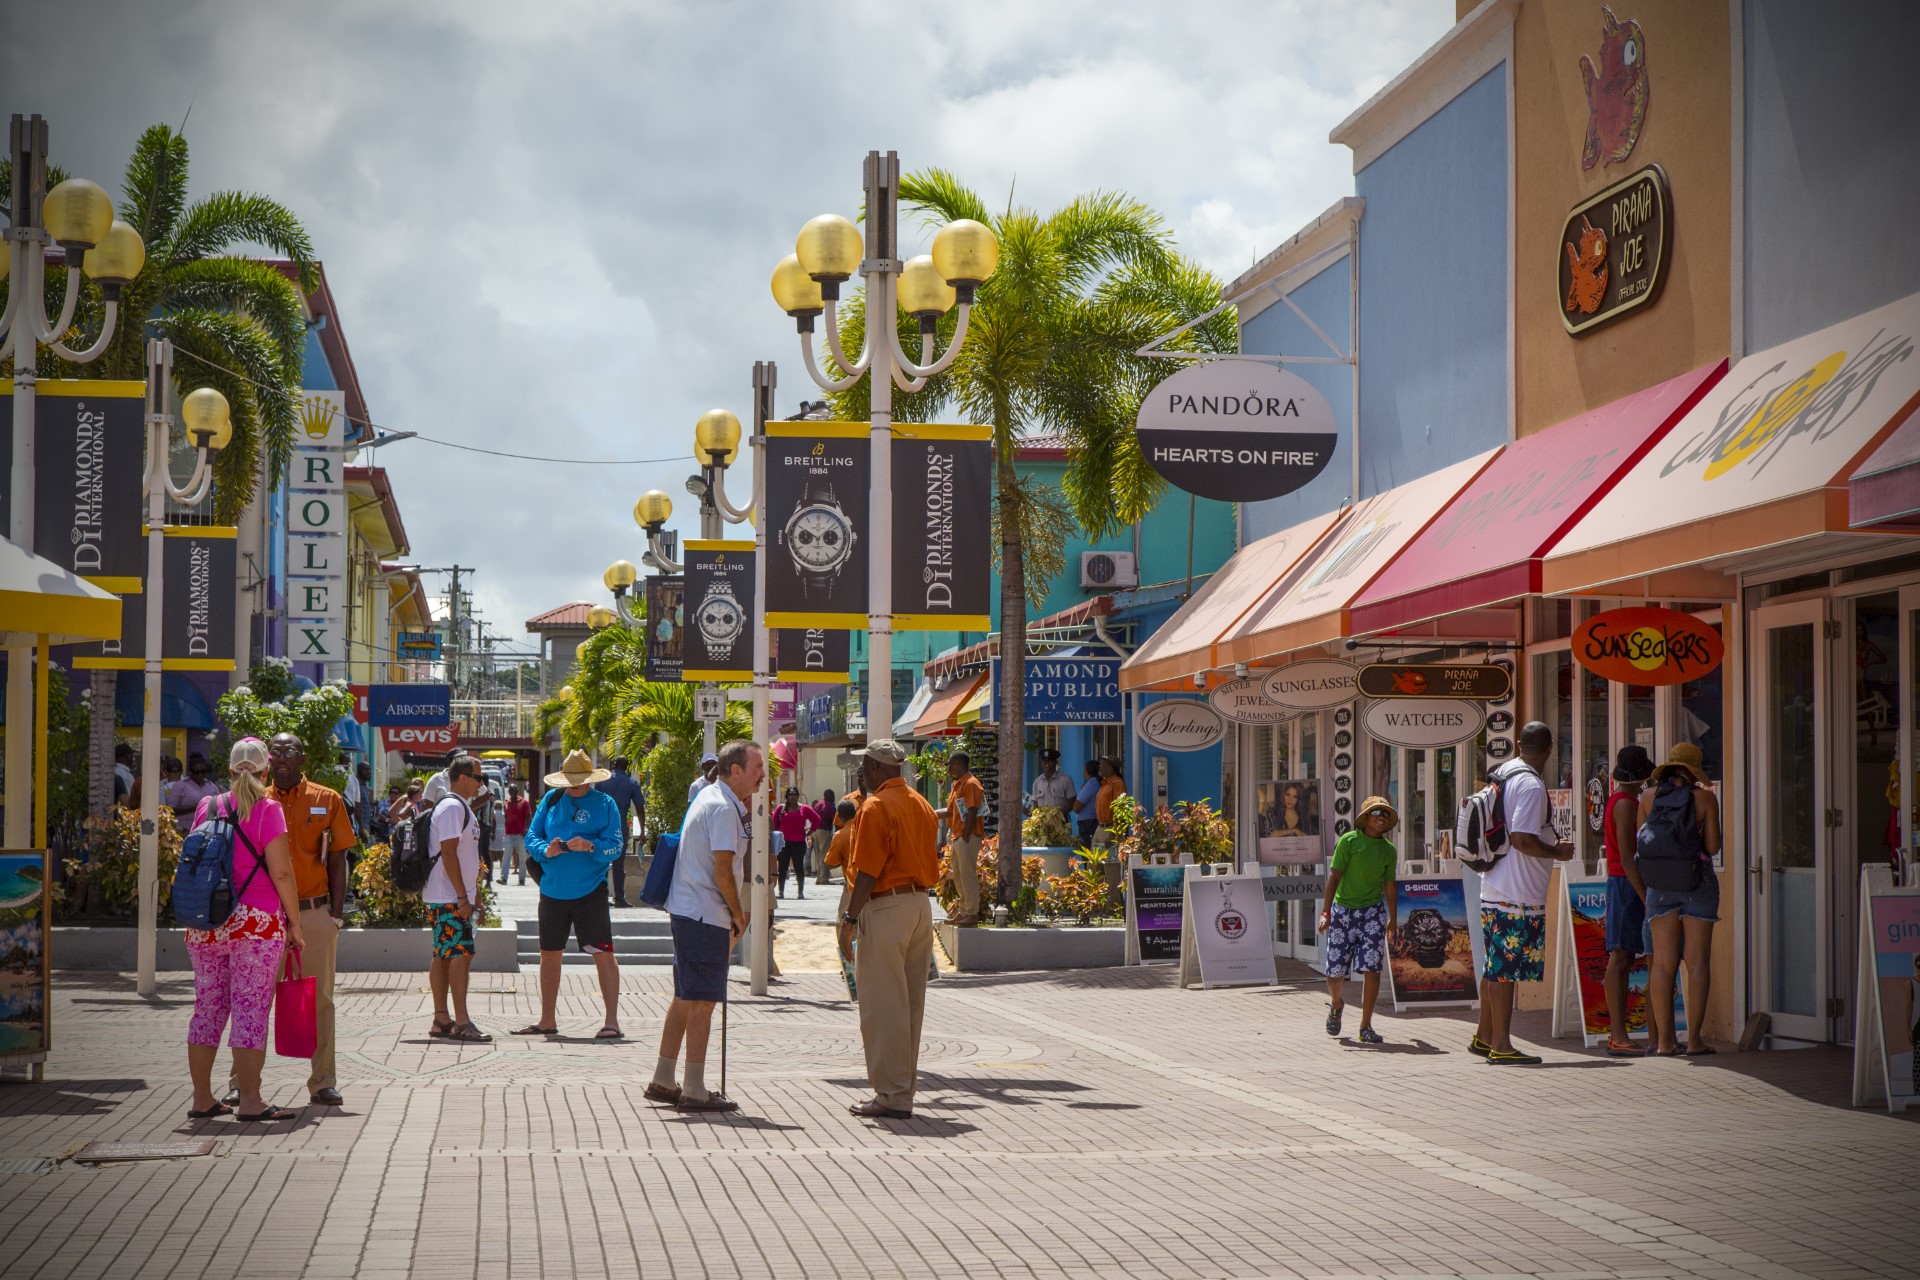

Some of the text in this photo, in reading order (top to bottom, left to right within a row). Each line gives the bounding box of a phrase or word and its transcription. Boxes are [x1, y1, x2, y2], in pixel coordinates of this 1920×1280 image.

[1620, 234, 1644, 278] JOE
[784, 456, 853, 466] BREITLING
[1153, 447, 1234, 464] HEARTS
[1237, 449, 1267, 465] ON
[91, 411, 105, 527] INTERNATIONAL
[809, 467, 829, 475] 1884
[942, 454, 954, 566] INTERNATIONAL
[300, 456, 335, 656] ROLEX
[696, 562, 745, 572] BREITLING
[200, 547, 210, 626] INTERNATIONAL
[1024, 664, 1112, 678] AMOND
[1221, 681, 1251, 696] SILVER
[1271, 676, 1357, 694] SUNGLASSES
[1452, 681, 1472, 691] JOE
[1064, 711, 1115, 720] WATCHES
[1236, 710, 1287, 721] DIAMONDS
[1384, 713, 1464, 727] WATCHES
[847, 723, 867, 731] INTE
[1143, 884, 1184, 895] marahlag
[1404, 883, 1440, 892] G-SHOCK
[1578, 894, 1607, 907] PIRA
